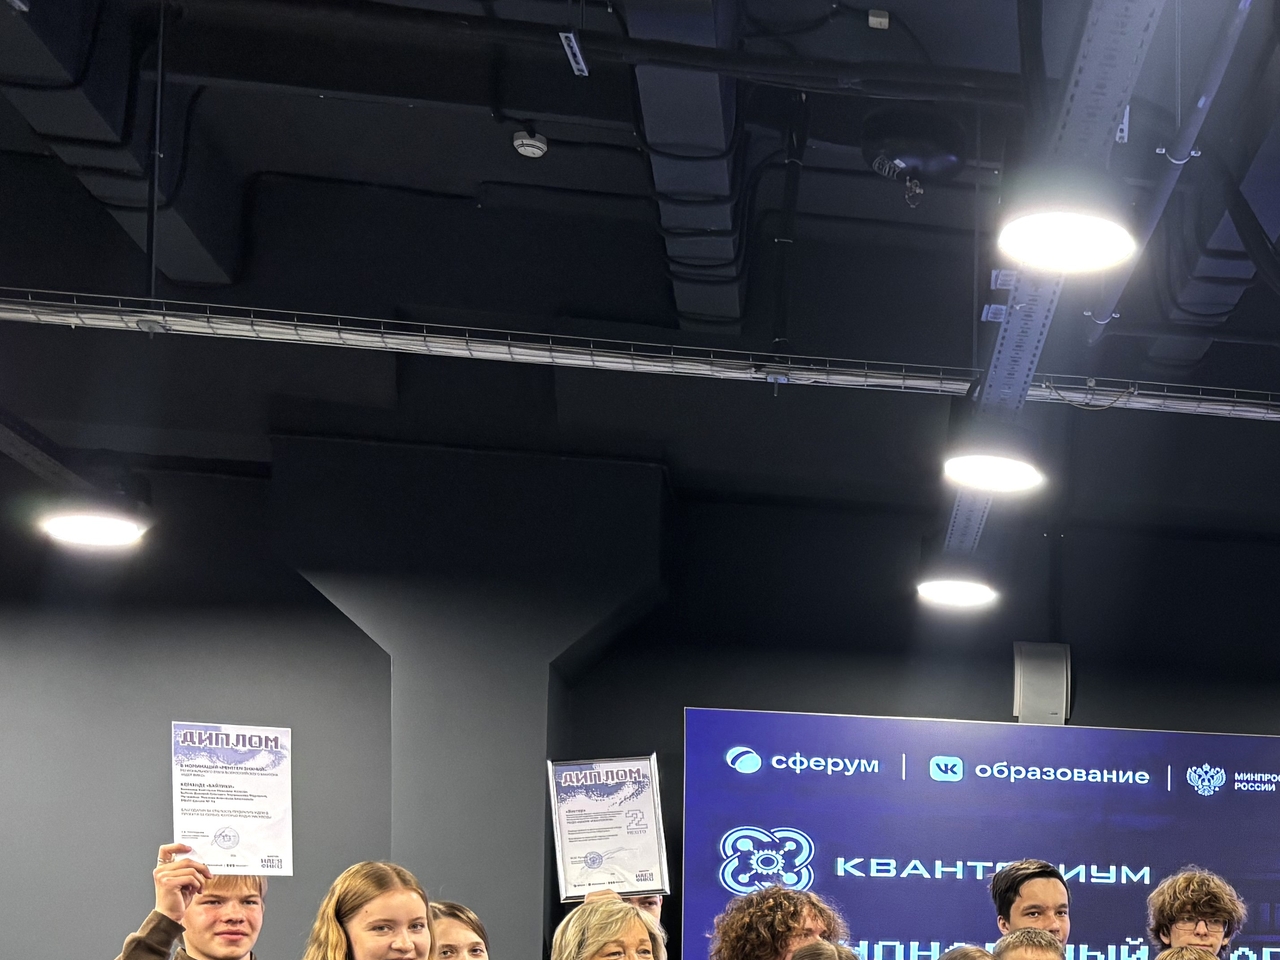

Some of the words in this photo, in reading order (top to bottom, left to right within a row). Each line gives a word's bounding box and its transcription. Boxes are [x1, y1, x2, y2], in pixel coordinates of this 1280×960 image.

[180, 730, 280, 750] ДИПЛОМ
[771, 752, 879, 775] сферум
[935, 763, 958, 776] VK
[975, 761, 1150, 784] образование
[562, 767, 642, 786] ДИПЛОМ
[1234, 782, 1276, 791] РОССИИ
[625, 809, 648, 830] 2
[836, 857, 1150, 884] КВАНТИУМ
